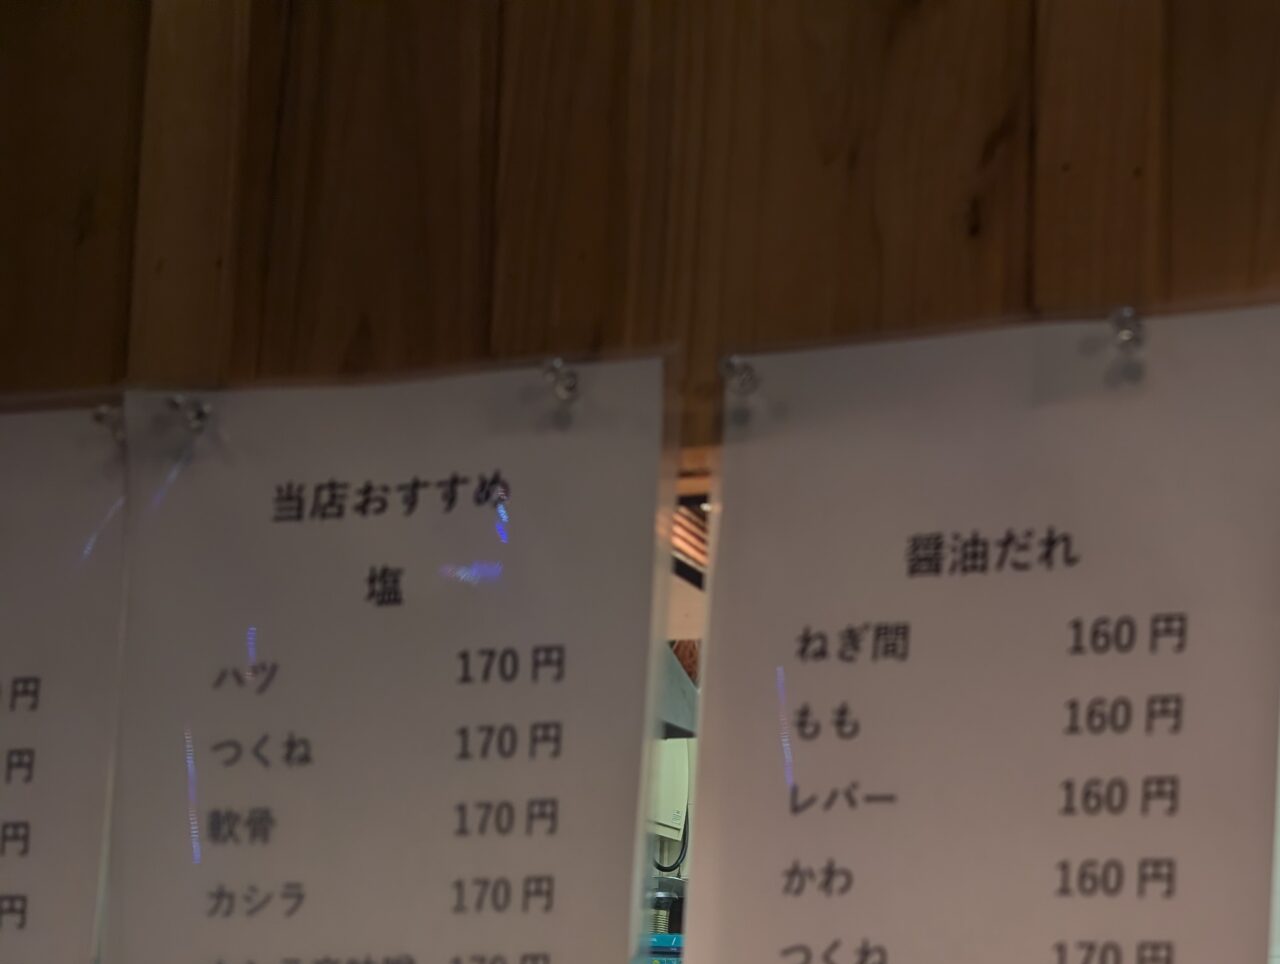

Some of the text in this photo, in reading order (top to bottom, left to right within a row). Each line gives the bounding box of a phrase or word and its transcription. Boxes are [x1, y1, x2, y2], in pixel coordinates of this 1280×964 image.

[271, 468, 513, 525] 当店おすすめ
[904, 525, 1081, 580] 醤油だれ
[363, 562, 408, 610] 塩
[794, 611, 1189, 665] ねぎ間 160円
[210, 643, 567, 698] ハツ 170円
[792, 692, 1185, 744] もも 160円
[209, 719, 564, 770] つくね 170円
[204, 796, 561, 846] 軟骨 170円
[786, 773, 1182, 819] レバー 160円
[204, 873, 556, 920] カシラ 170円
[781, 856, 1178, 901] かわ 160円
